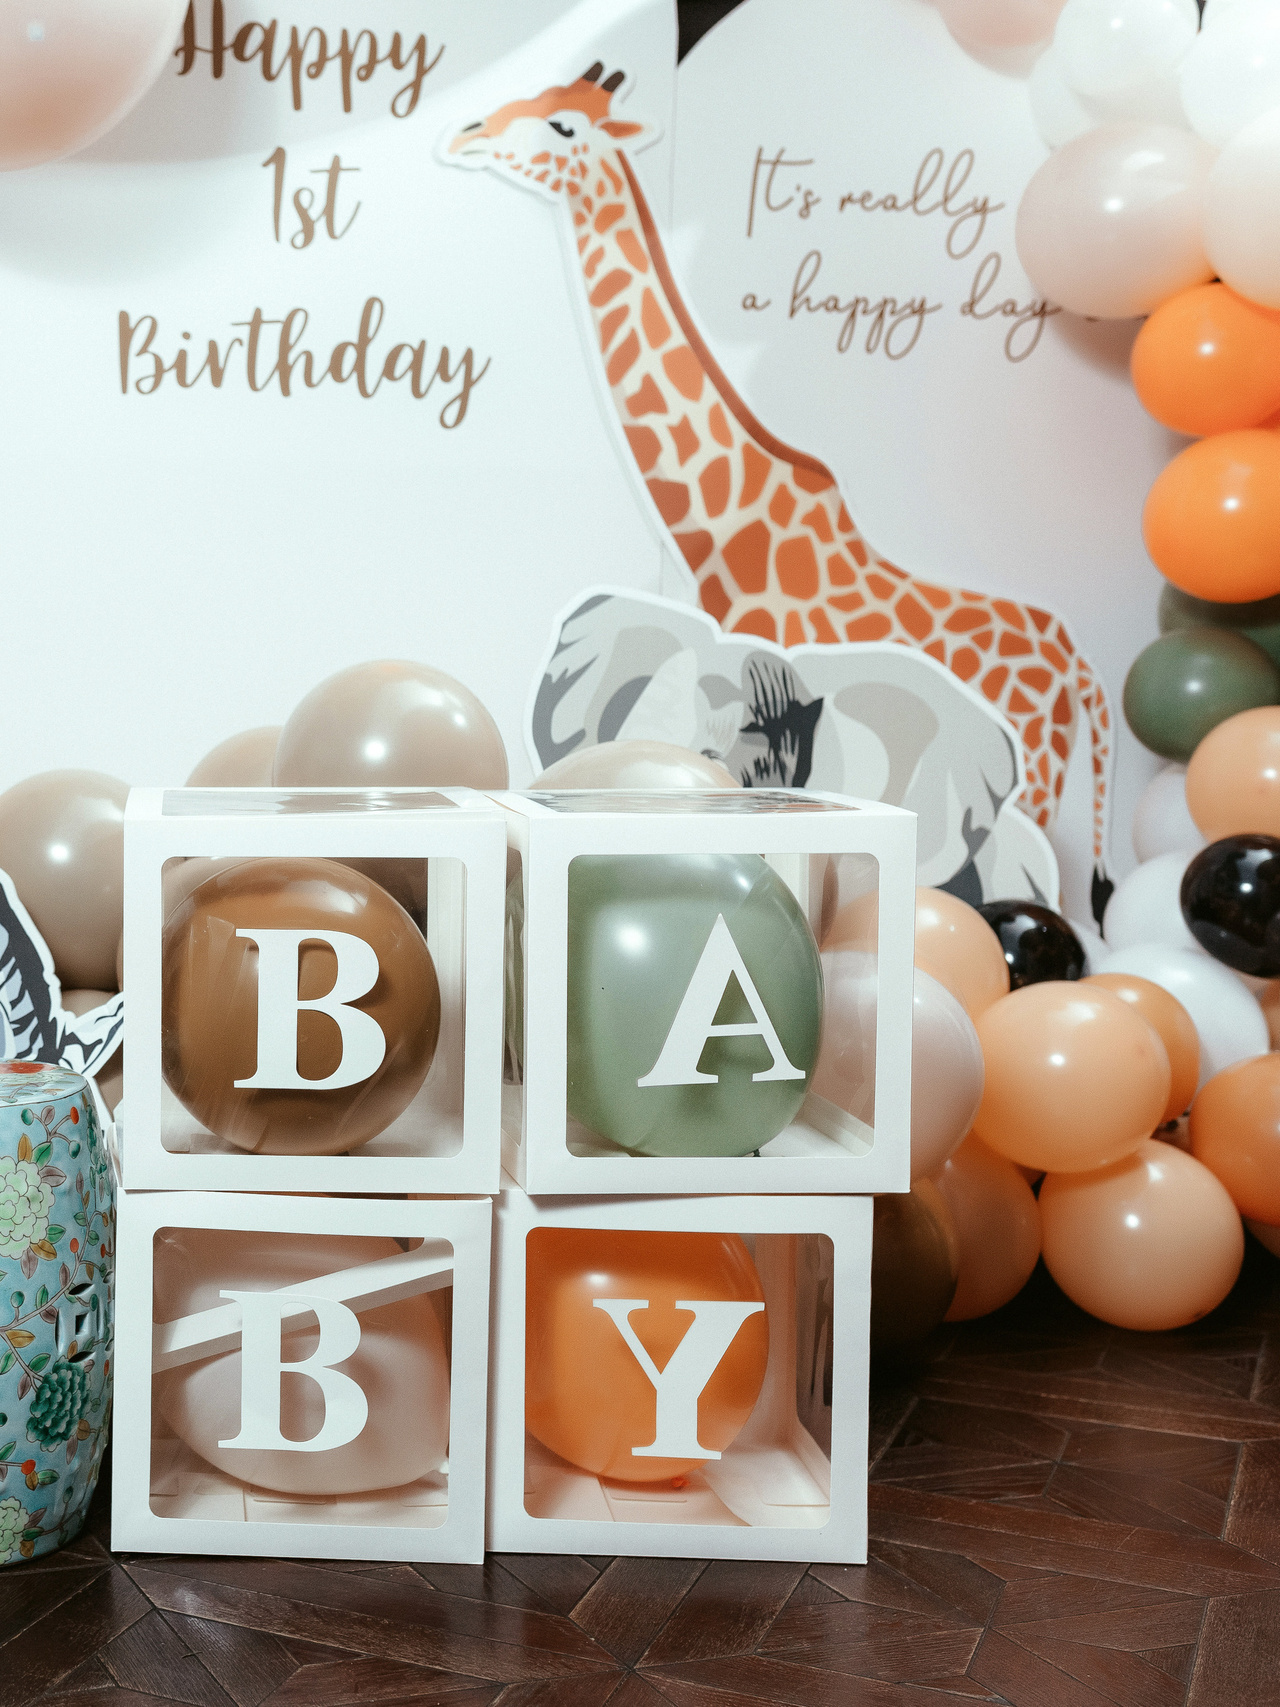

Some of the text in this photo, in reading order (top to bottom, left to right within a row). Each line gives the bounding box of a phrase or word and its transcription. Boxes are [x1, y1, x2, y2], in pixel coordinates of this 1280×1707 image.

[175, 0, 446, 118] Happy
[261, 146, 362, 249] 1st
[746, 146, 1006, 260] It's really
[118, 296, 492, 429] Birthday
[741, 249, 1063, 363] a happy day
[233, 927, 388, 1090] B
[637, 913, 806, 1087] A
[217, 1289, 369, 1453] B
[592, 1298, 766, 1460] Y
